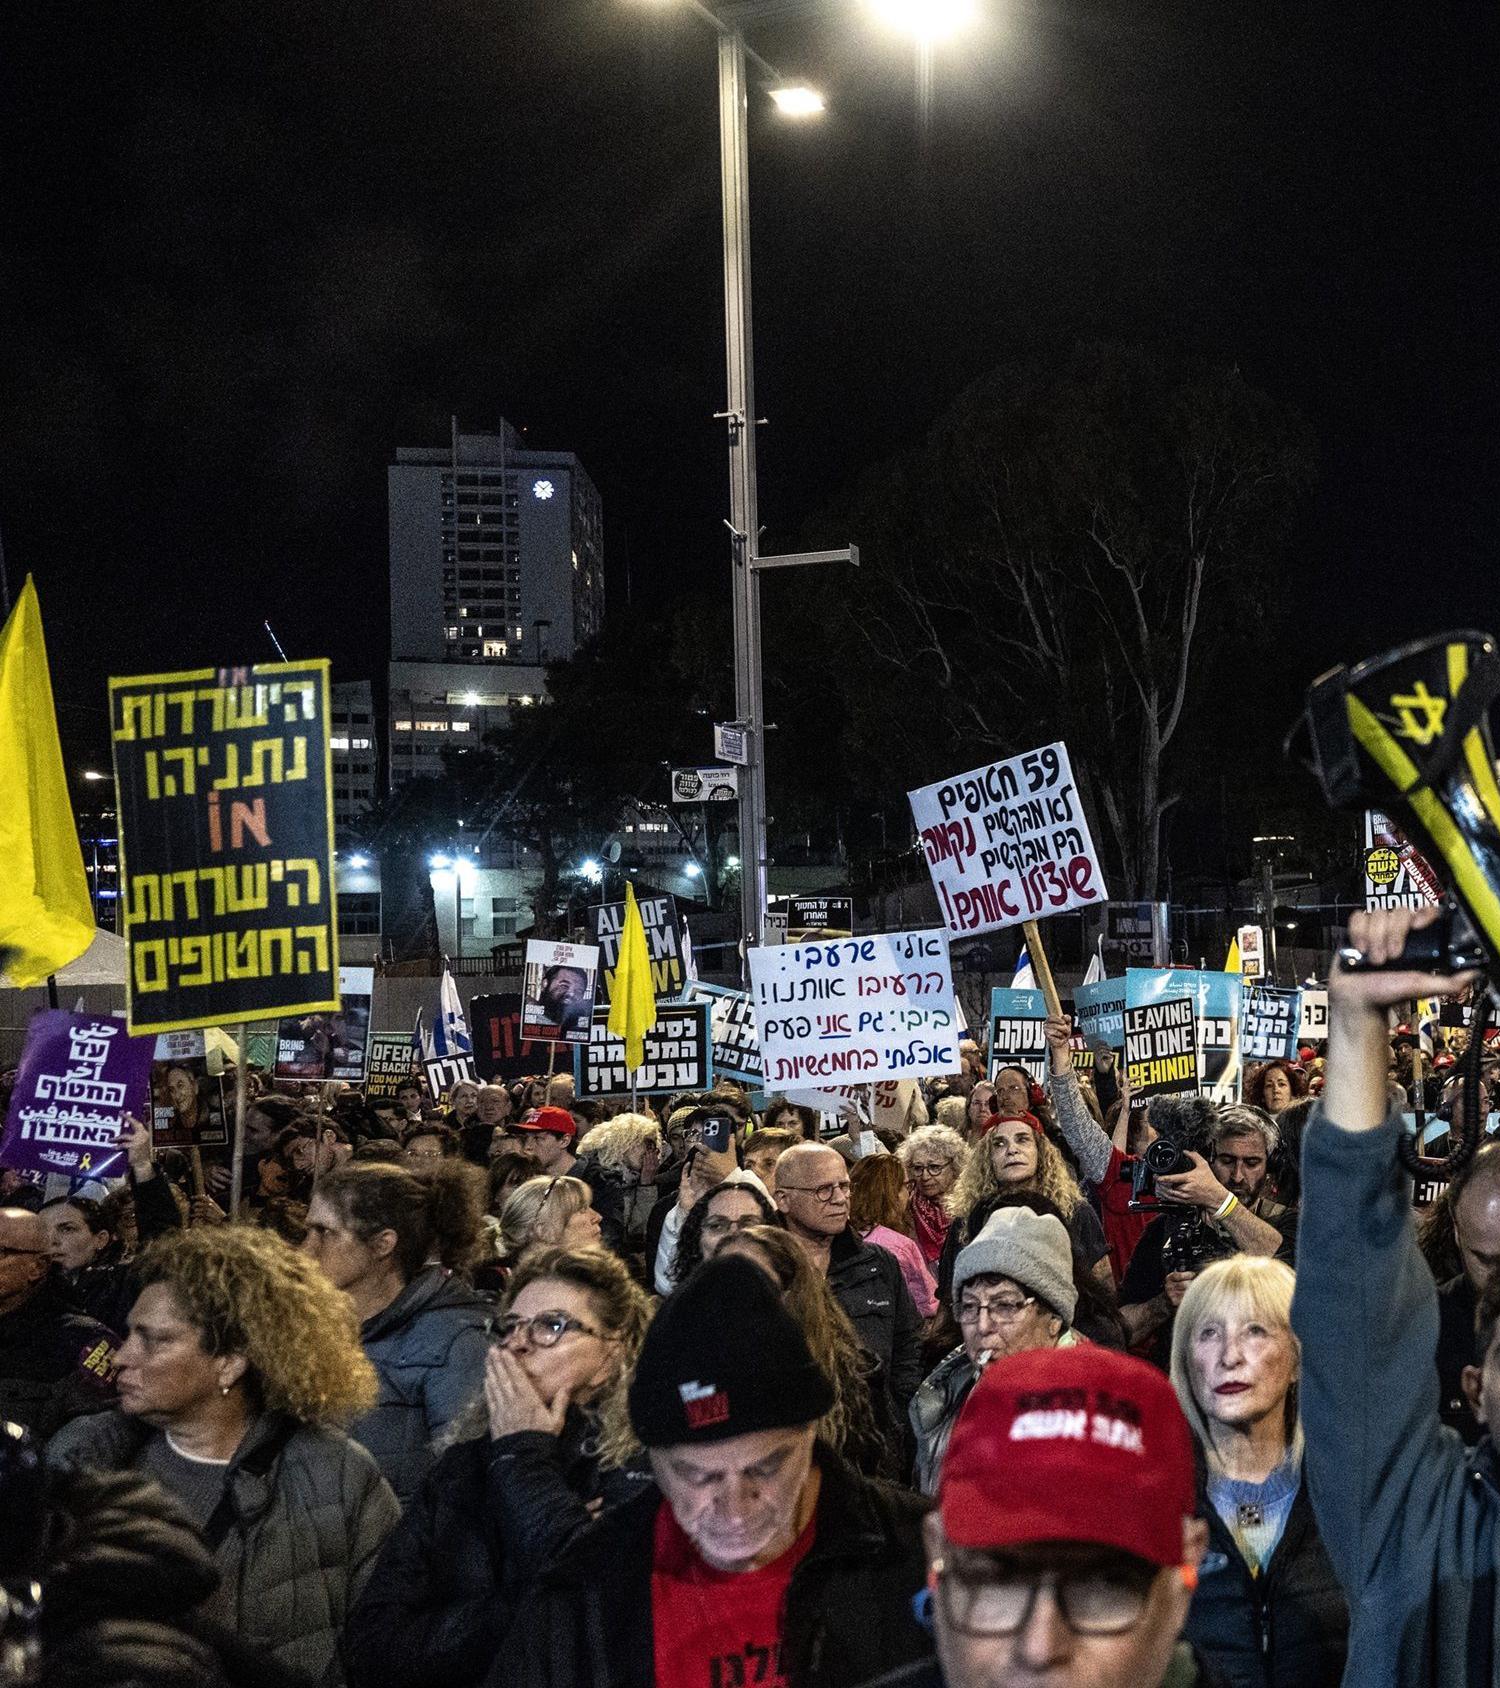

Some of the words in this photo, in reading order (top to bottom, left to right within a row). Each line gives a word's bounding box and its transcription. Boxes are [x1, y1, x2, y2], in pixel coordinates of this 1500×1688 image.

[112, 680, 315, 741] הישרדות
[145, 736, 307, 800] נתניהו
[1022, 748, 1059, 793] 59
[937, 765, 1019, 820] חטופים
[1045, 784, 1073, 825] לא
[208, 790, 272, 851] או
[982, 798, 1046, 846] מבקשים
[921, 817, 977, 874] נקמה
[980, 835, 1050, 878] מבקשים
[1052, 827, 1085, 859] הם
[1368, 859, 1398, 873] אשם
[125, 858, 321, 924] הישרדות
[597, 905, 627, 935] AL
[640, 899, 667, 928] OF
[803, 911, 828, 920] האחרון
[134, 925, 329, 993] החטופים
[858, 972, 943, 997] הרעיבו
[69, 1022, 119, 1041] حتى
[765, 1016, 811, 1041] פעם
[1098, 1014, 1124, 1034] סקה
[1125, 1002, 1192, 1034] LEAVING
[74, 1041, 106, 1058] עד
[279, 1039, 305, 1051] BRING
[279, 1051, 295, 1062] HIM
[372, 1043, 413, 1062] OFER
[588, 1040, 698, 1064] המלמה
[1126, 1034, 1154, 1062] NO
[1155, 1026, 1194, 1057] ONE
[370, 1062, 381, 1072] IS
[381, 1062, 411, 1074] BACK!
[370, 1074, 385, 1084] TOO
[588, 1062, 698, 1092] עכשיו!
[1128, 1056, 1195, 1088] BEHIND!
[40, 1078, 122, 1104] החטוף
[367, 1084, 386, 1096] NOT
